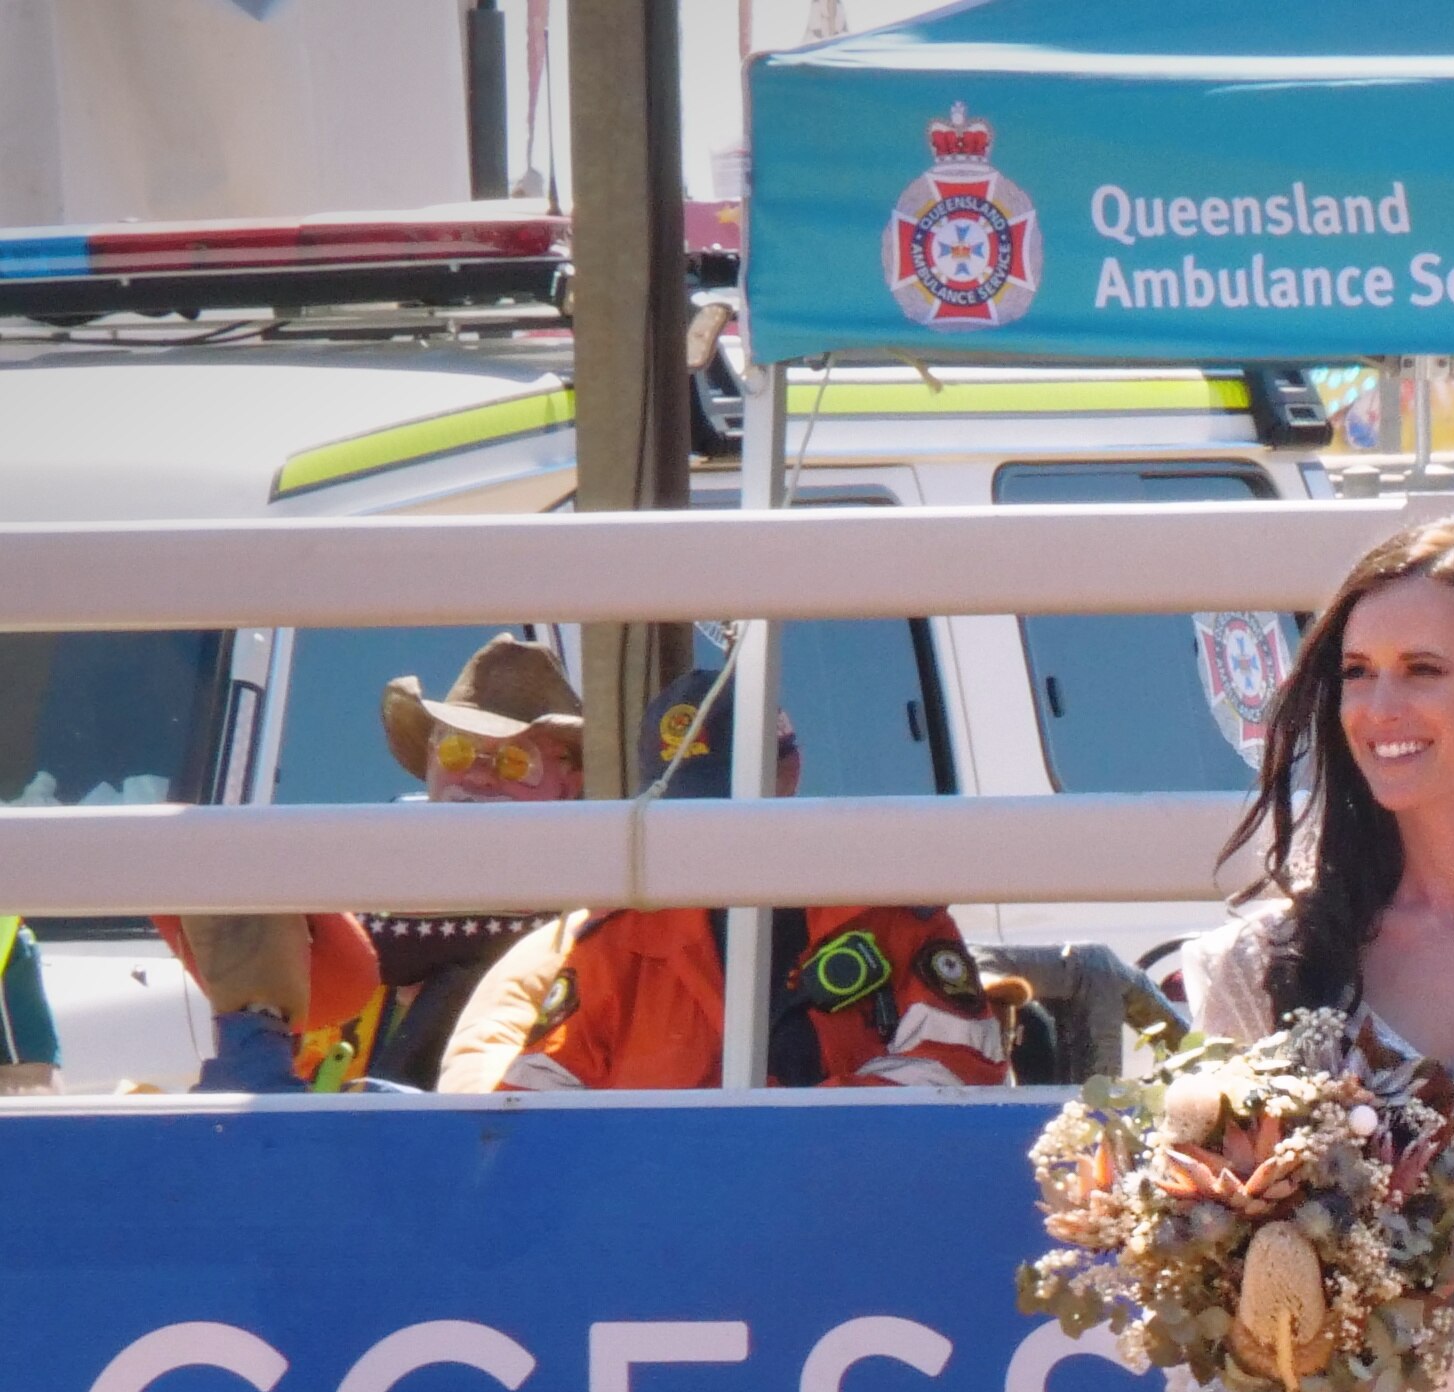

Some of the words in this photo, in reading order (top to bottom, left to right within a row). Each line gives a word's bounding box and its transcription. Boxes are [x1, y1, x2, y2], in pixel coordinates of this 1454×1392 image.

[920, 196, 1006, 231] QUEENSLAND
[1091, 182, 1411, 245] Queensland
[911, 245, 977, 305] AMBULANCE
[979, 243, 1012, 299] SERVICE
[1095, 254, 1394, 309] Ambulance
